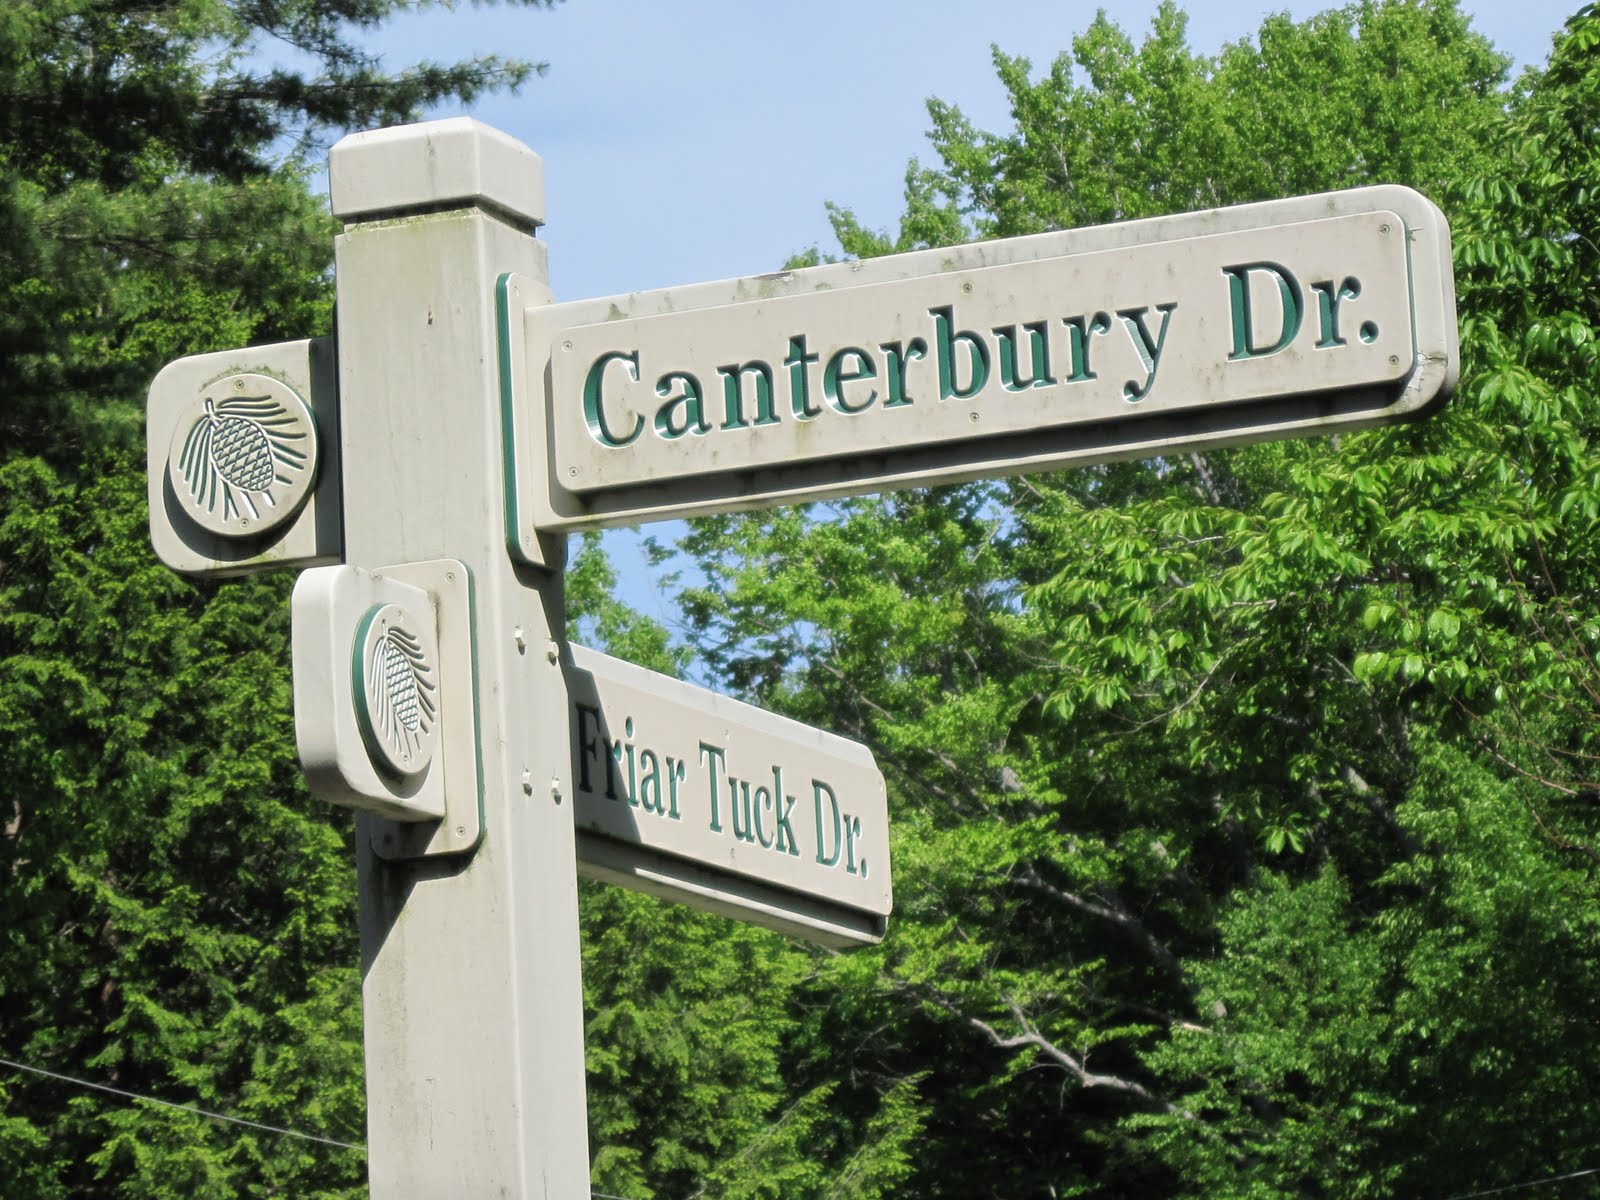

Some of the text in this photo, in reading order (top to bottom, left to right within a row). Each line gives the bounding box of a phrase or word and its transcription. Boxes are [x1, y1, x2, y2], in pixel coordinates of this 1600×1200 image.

[583, 260, 1380, 449] Canterbury Dr.
[575, 702, 869, 879] Friar Tuck Dr.
